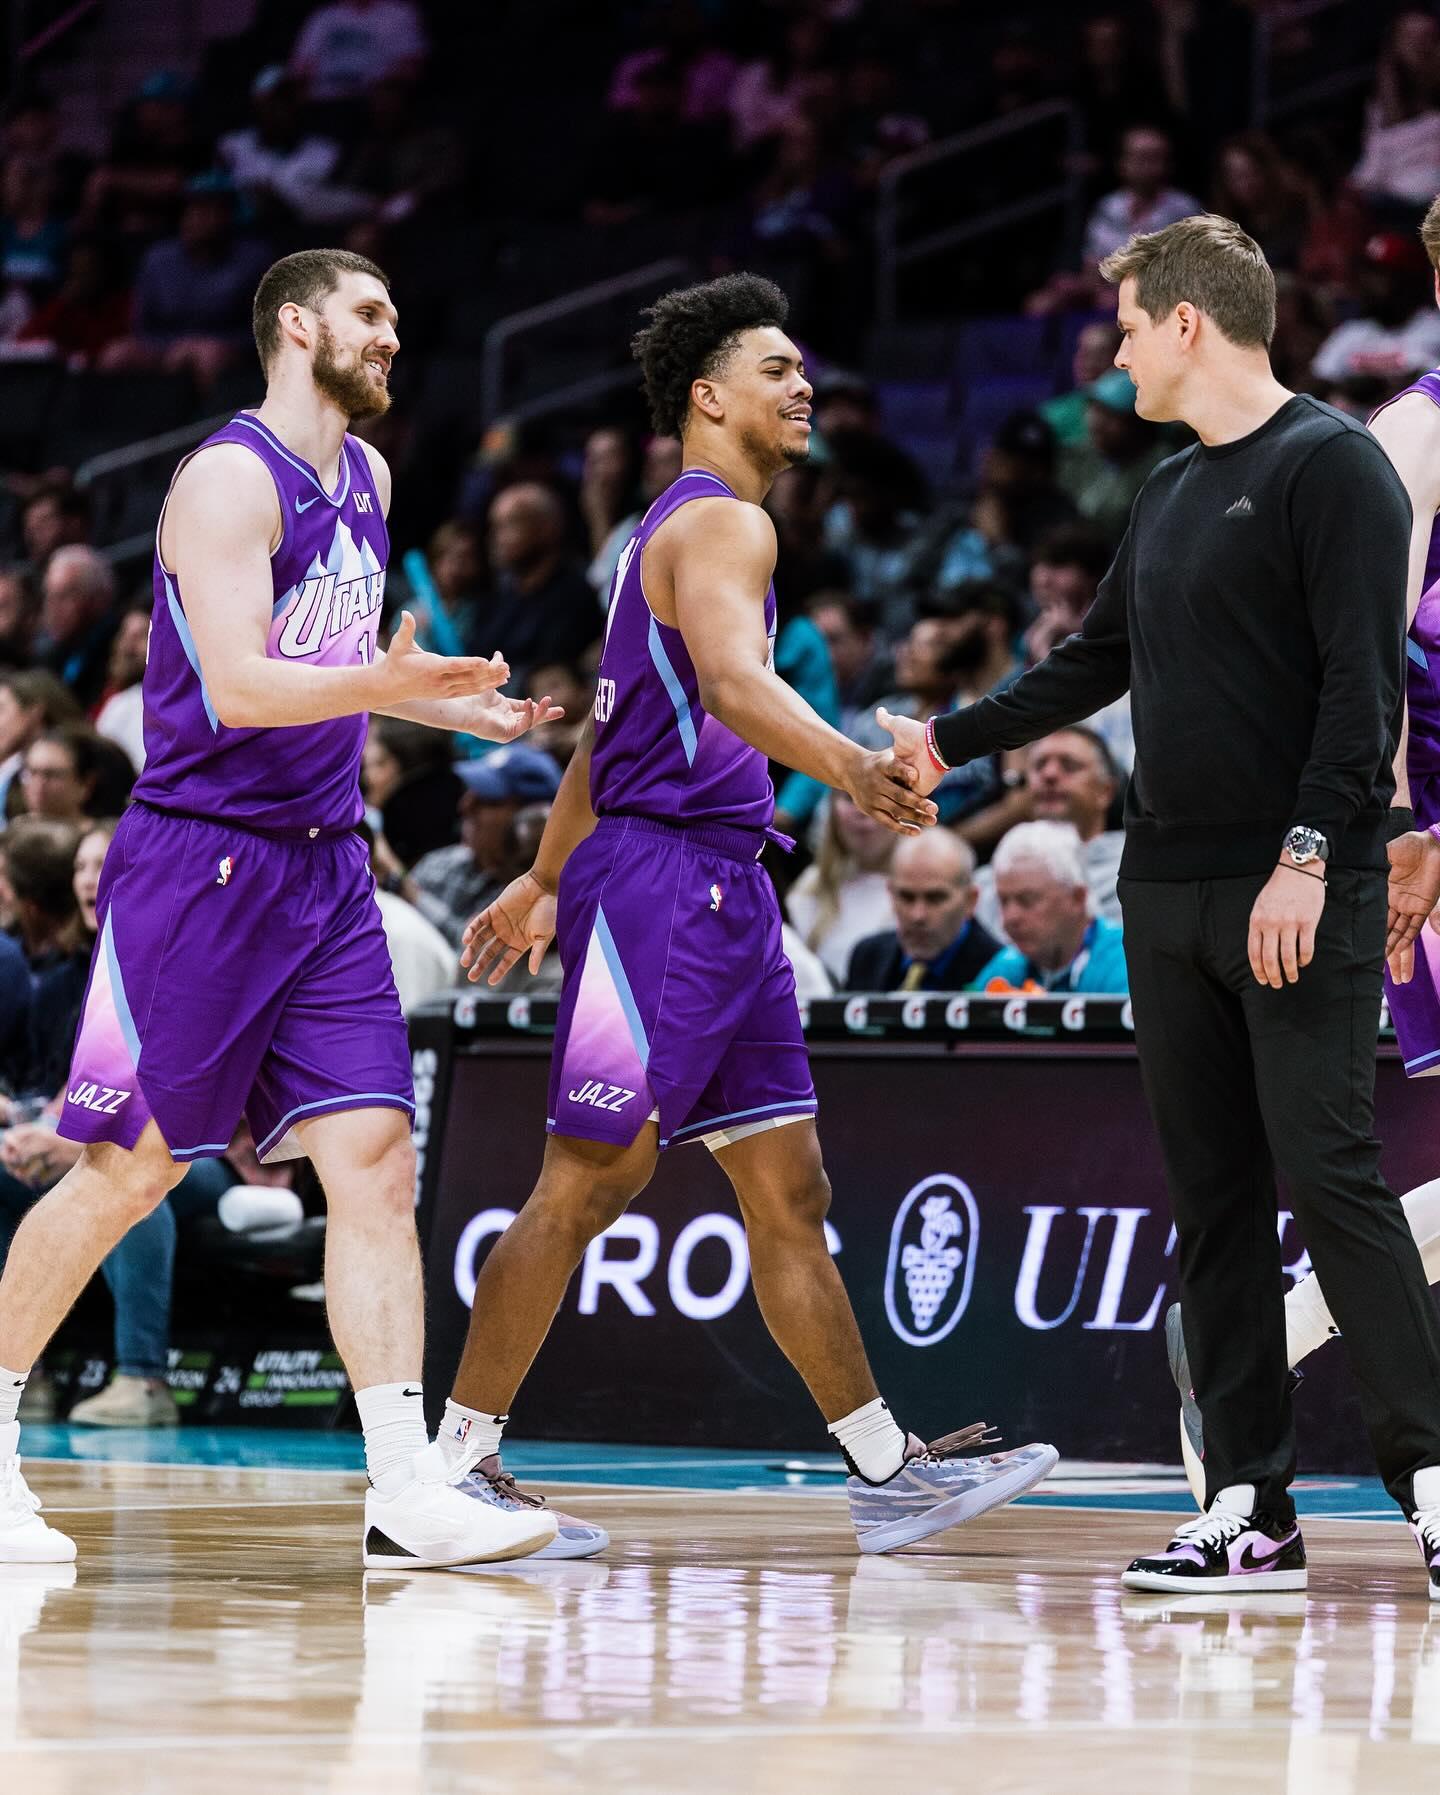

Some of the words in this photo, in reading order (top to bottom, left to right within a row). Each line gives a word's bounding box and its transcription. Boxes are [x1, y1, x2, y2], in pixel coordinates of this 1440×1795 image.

[278, 570, 386, 658] UTAH
[67, 1081, 132, 1114] JAZZ
[568, 1079, 637, 1113] JAZZ
